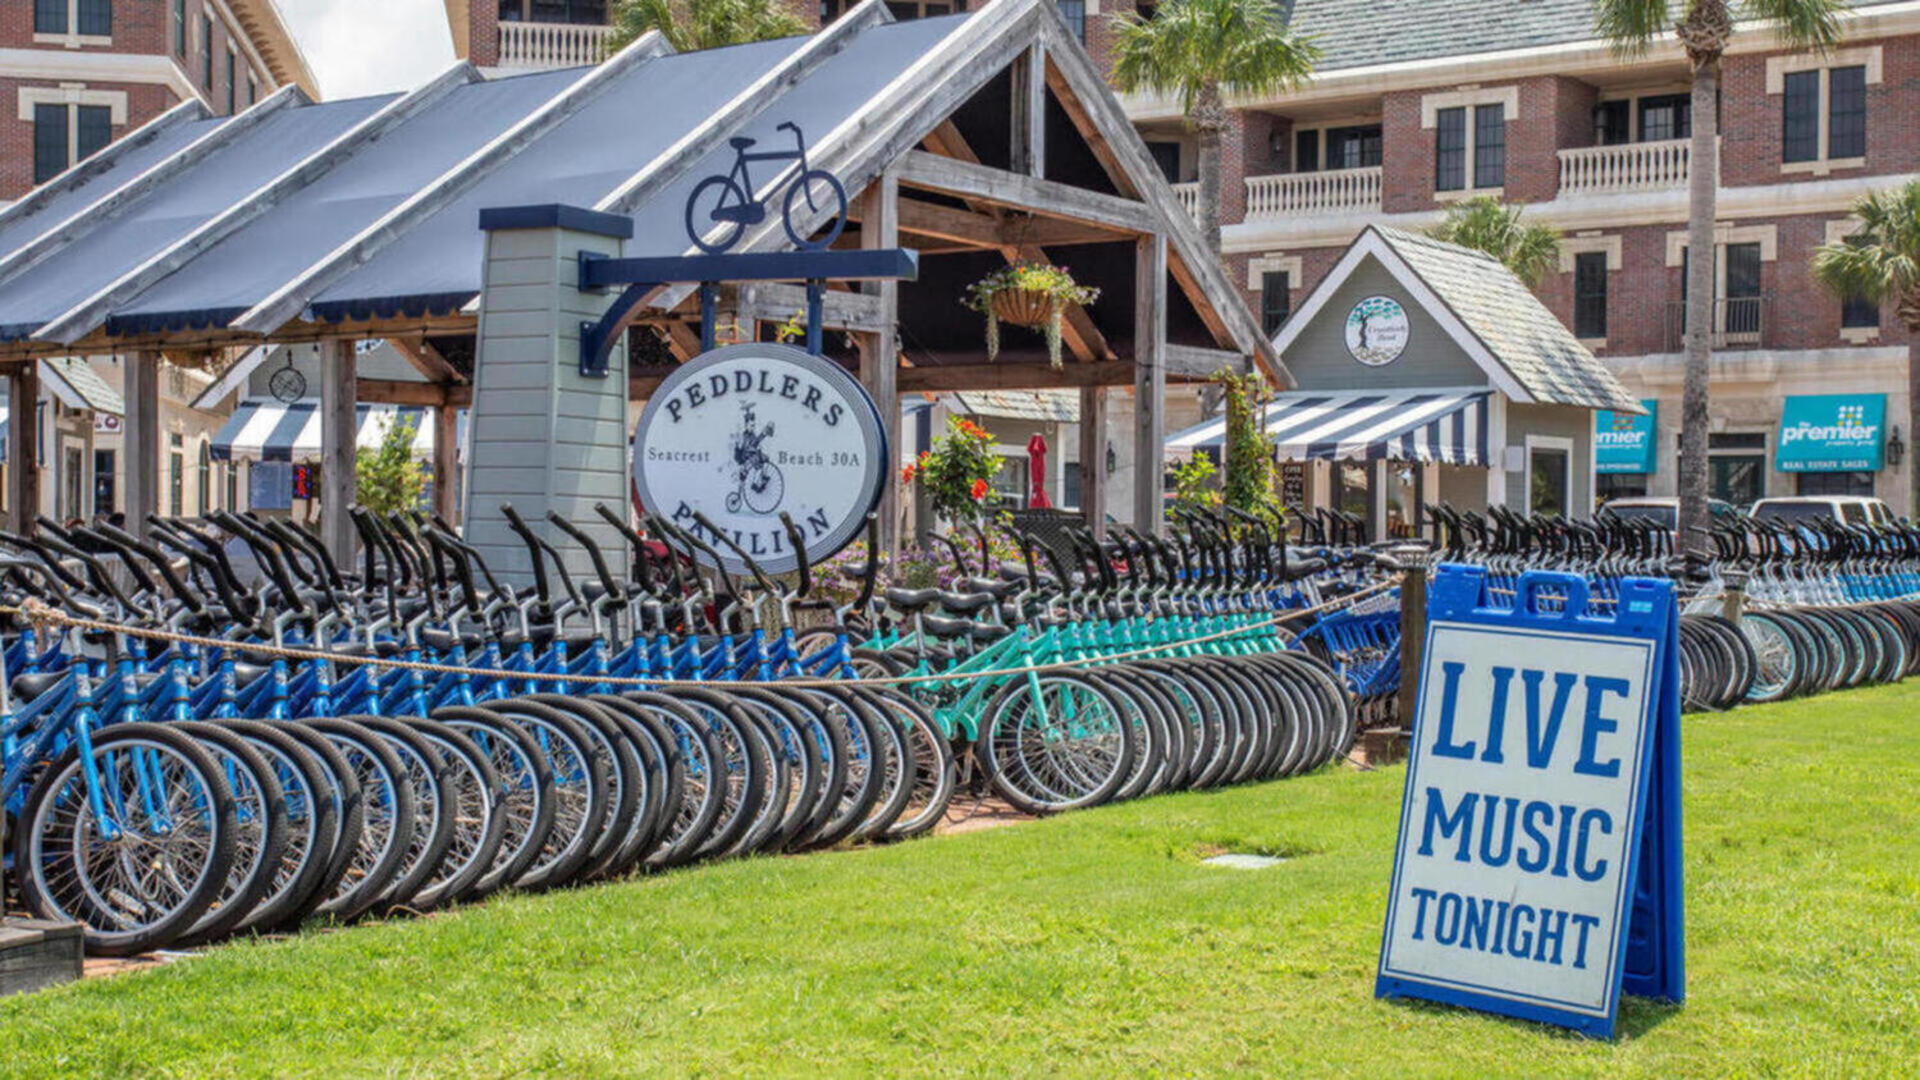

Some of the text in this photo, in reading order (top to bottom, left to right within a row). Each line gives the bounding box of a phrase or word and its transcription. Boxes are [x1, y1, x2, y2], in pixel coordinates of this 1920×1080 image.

[665, 369, 844, 427] PEDDLERS
[648, 449, 860, 466] Seacrest Beach 30A
[1595, 431, 1646, 444] mier
[1781, 425, 1877, 446] premier
[1431, 660, 1630, 778] LIVE
[1417, 786, 1612, 883] MUSIC
[1411, 886, 1600, 970] TONIGHT
